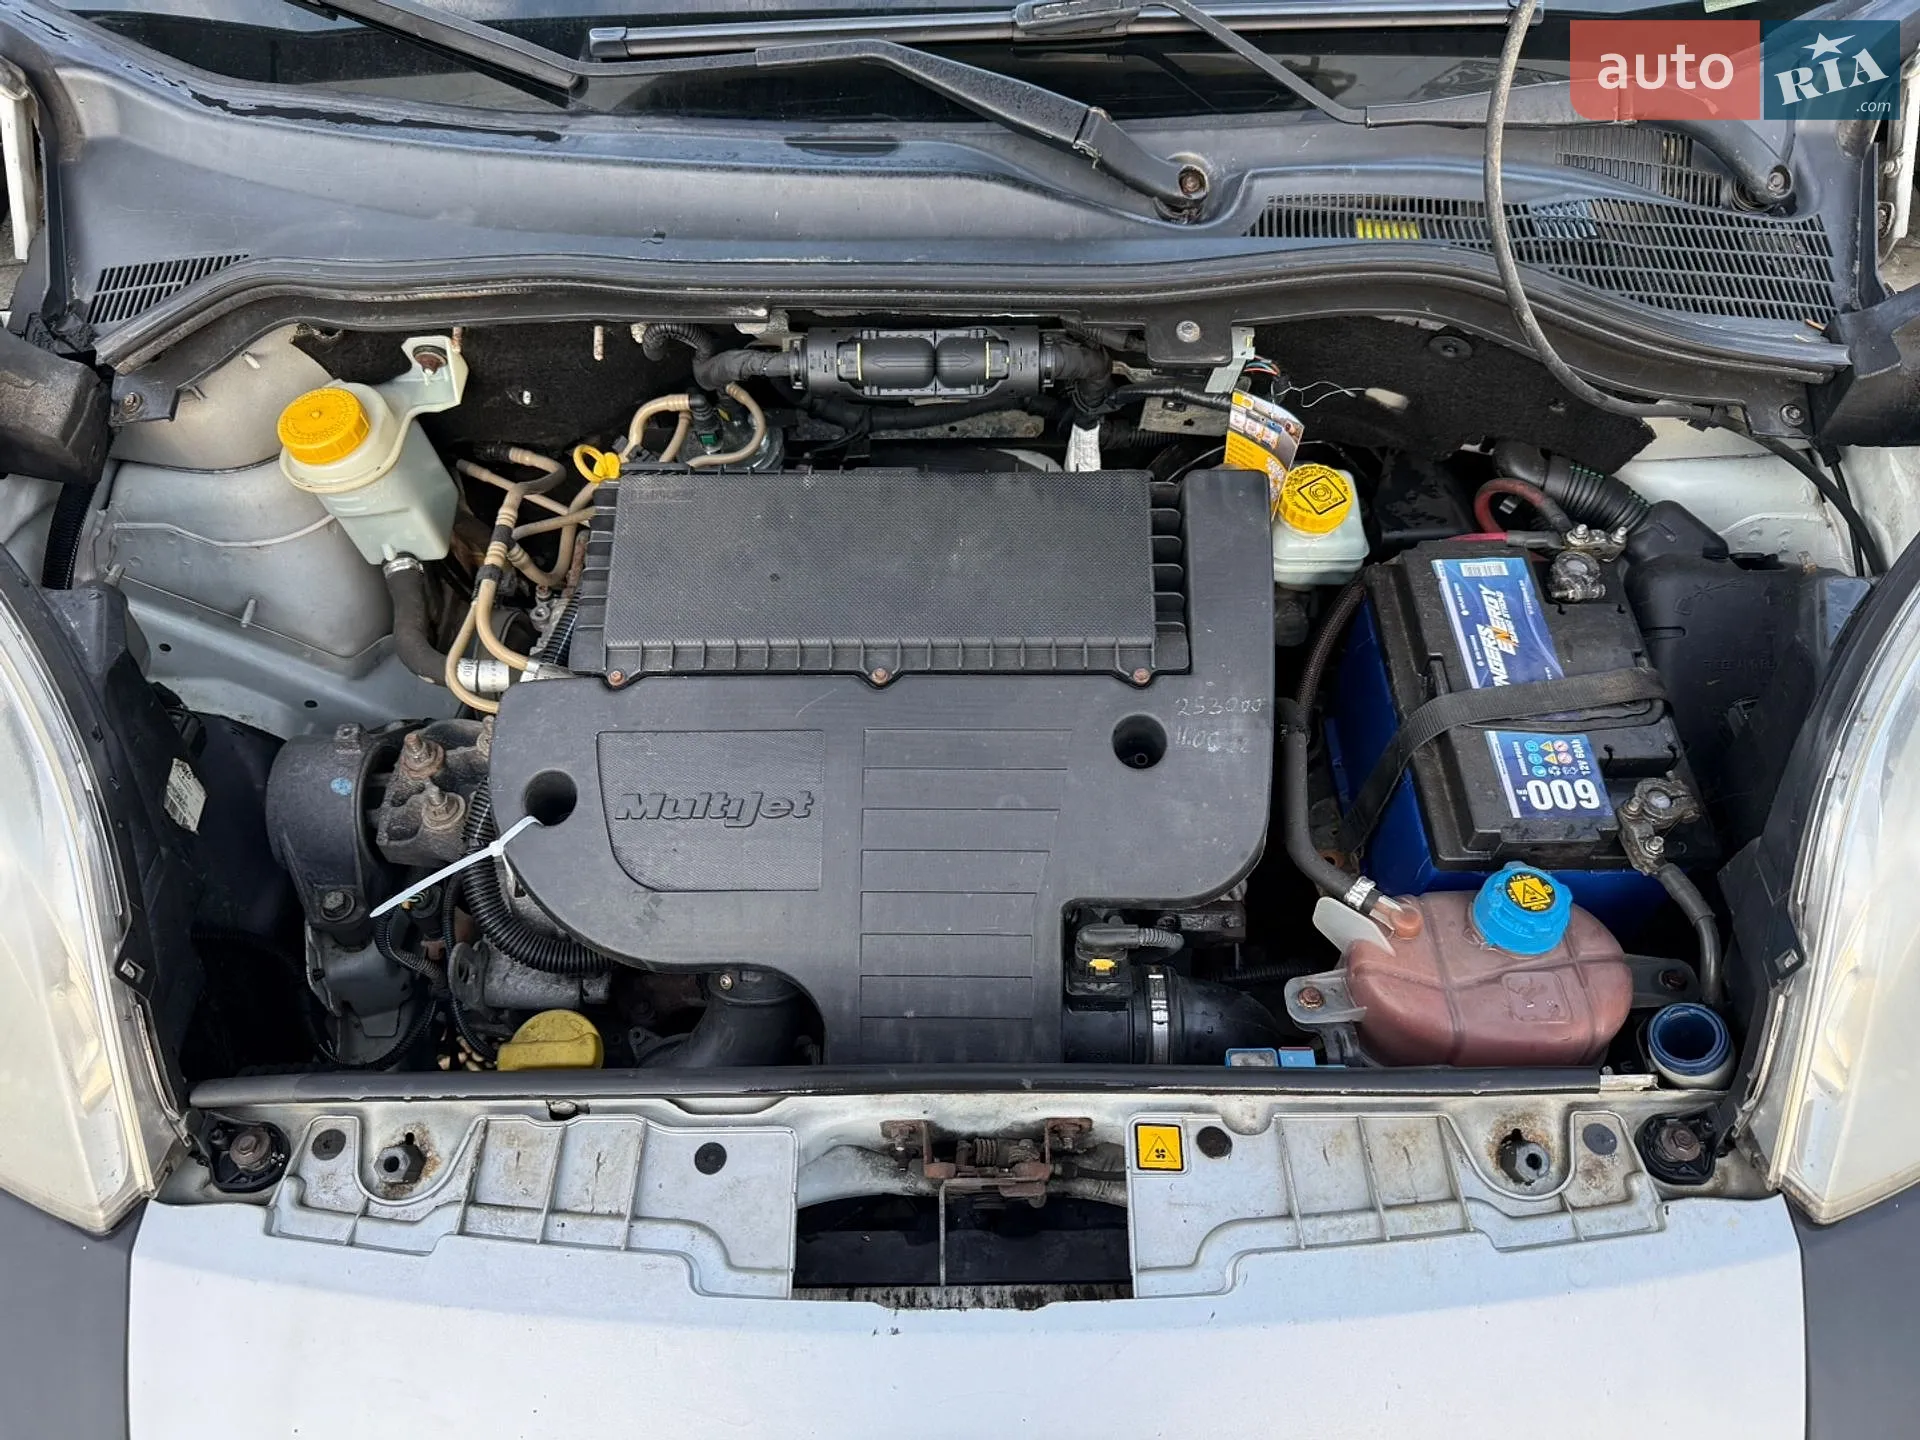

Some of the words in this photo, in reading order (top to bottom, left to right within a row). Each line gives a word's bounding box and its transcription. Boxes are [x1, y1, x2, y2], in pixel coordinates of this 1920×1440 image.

[1478, 583, 1518, 656] ENERGY
[1578, 760, 1592, 775] 12V
[1526, 778, 1600, 811] 600
